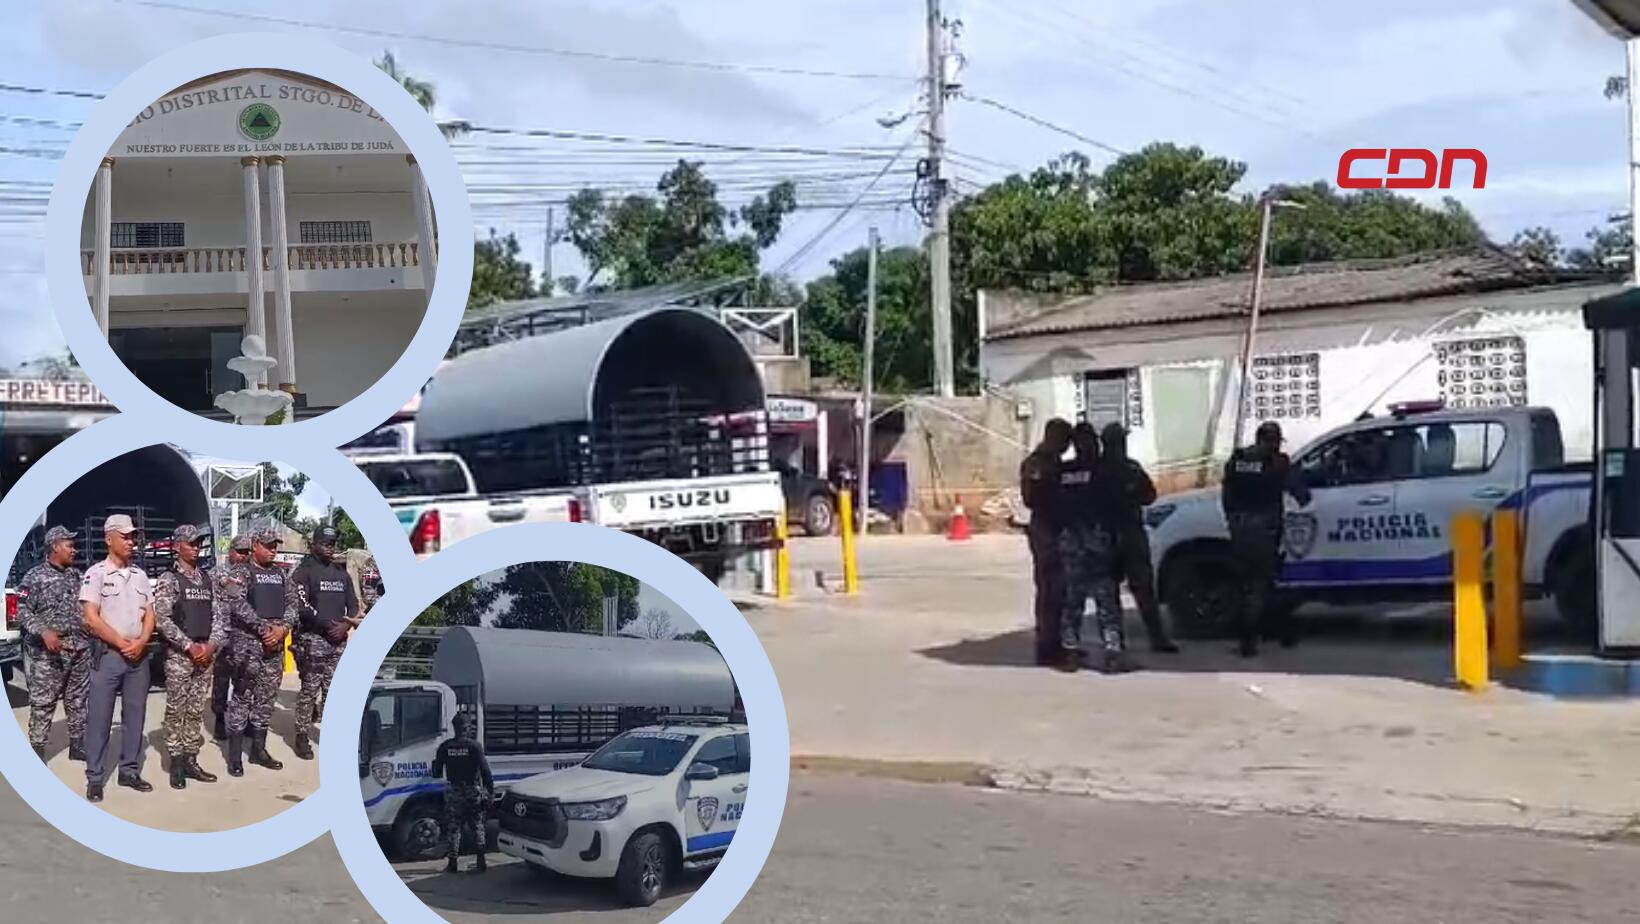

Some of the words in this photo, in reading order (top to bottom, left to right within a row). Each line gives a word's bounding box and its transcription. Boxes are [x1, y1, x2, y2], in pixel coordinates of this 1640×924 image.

[126, 105, 154, 127] IO
[160, 85, 272, 115] DISTRITAL
[279, 85, 334, 106] STGO.
[337, 94, 364, 114] DE
[127, 144, 177, 153] NUESTRO
[180, 144, 221, 153] FUERTE
[223, 144, 236, 152] ES
[238, 144, 252, 152] EL
[284, 143, 298, 151] DE
[300, 143, 317, 151] LA
[317, 142, 348, 151] TRIBU
[351, 142, 364, 150] DE
[367, 140, 394, 151] JUDÁ
[649, 489, 730, 509] ISUZU
[1337, 512, 1427, 530] POLICIA
[1327, 525, 1441, 542] NACIONAL
[397, 762, 428, 770] POLICIA
